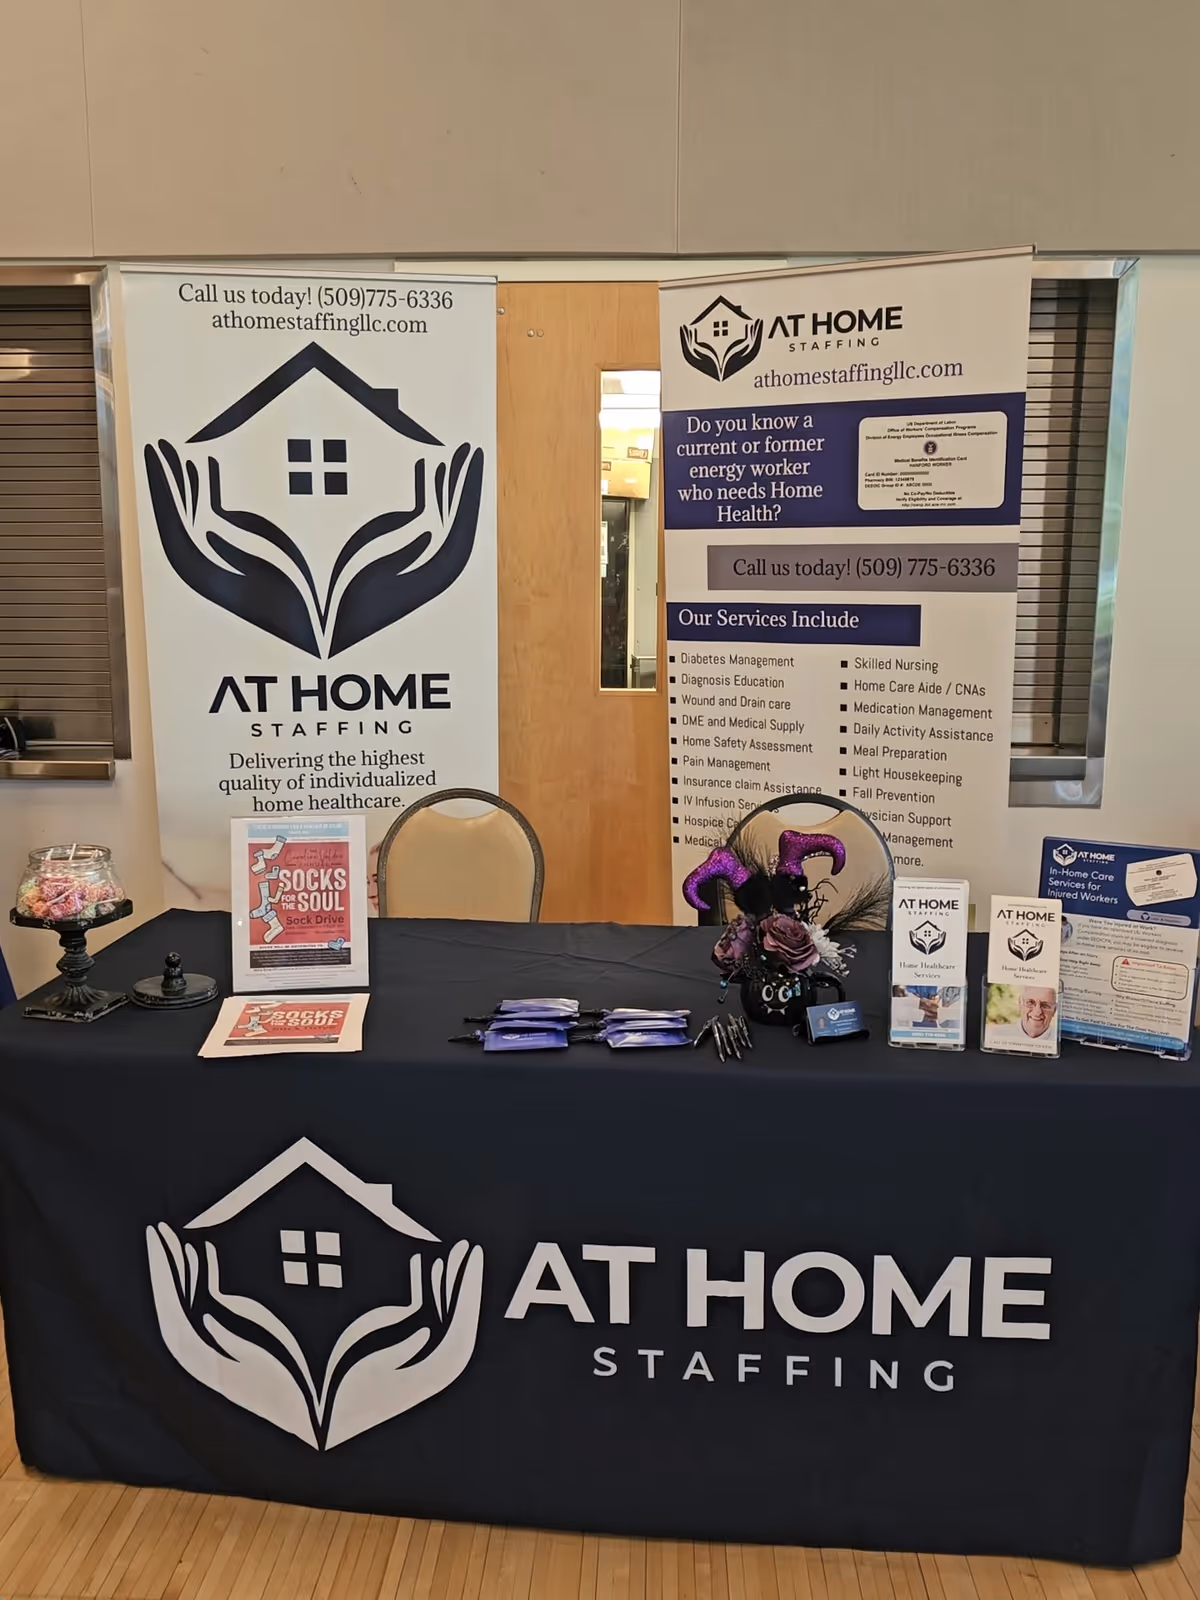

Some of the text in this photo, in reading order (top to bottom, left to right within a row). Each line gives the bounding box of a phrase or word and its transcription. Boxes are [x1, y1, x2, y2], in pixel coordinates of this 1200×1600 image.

[179, 283, 453, 310] Call us today! (509)775-6336
[212, 310, 428, 337] athomestaffingllc.com
[768, 306, 903, 339] AT HOME
[788, 337, 880, 352] STAFFING
[753, 361, 964, 388] athomestaffingllc.com
[686, 413, 814, 437] Do you know a
[676, 436, 825, 457] current or former
[689, 458, 811, 482] energy worker
[677, 481, 823, 502] who needs Home
[717, 504, 782, 522] Health?
[733, 557, 996, 580] Call us today! (509) 775-6336
[678, 608, 860, 629] Our Services Include
[680, 652, 795, 668] Diabetes Management
[854, 657, 939, 674] Skilled Nursing
[681, 673, 785, 688] Diagnosis Education
[854, 679, 886, 692] Home
[889, 681, 915, 693] Care
[918, 682, 943, 694] Aide
[955, 683, 986, 697] CNAs
[208, 673, 452, 714] AT HOME
[681, 694, 792, 711] Wound and Drain care
[854, 701, 993, 720] Medication Management
[250, 720, 413, 738] STAFFING
[682, 714, 805, 734] DME and Medical Supply
[853, 723, 994, 742] Daily Activity Assistance
[682, 735, 813, 754] Home Safety Assessment
[853, 745, 947, 761] Meal Preparation
[229, 750, 426, 771] Delivering the highest
[683, 755, 771, 772] Pain Management
[218, 770, 437, 796] quality of individualized
[683, 775, 822, 795] Insurance claim Assistance
[852, 766, 963, 787] Light Housekeeping
[253, 794, 406, 812] home healthcare.
[683, 796, 693, 806] IV
[695, 797, 735, 809] Infusion
[852, 787, 936, 804] Fall Prevention
[685, 815, 724, 828] Hospice
[908, 811, 952, 828] Support
[685, 835, 723, 847] Medical
[882, 832, 954, 848] Management
[893, 855, 924, 867] more.
[1090, 852, 1116, 862] HOME
[279, 868, 347, 891] SOCKS
[1049, 867, 1114, 882] In-Home Care
[1048, 877, 1101, 891] Services for
[281, 894, 296, 902] FOR
[297, 891, 345, 912] SOUL
[898, 898, 959, 910] AT HOME
[1047, 888, 1118, 905] Injured Workers
[282, 902, 296, 910] THE
[286, 916, 313, 926] Sock
[315, 915, 345, 924] Drive
[997, 909, 1056, 922] AT HOME
[920, 961, 956, 969] Healthcare
[913, 971, 941, 979] Services
[272, 1010, 344, 1020] SOCKS
[287, 1018, 338, 1026] SOUL
[503, 1241, 1052, 1340] AT HOME
[592, 1346, 955, 1392] STAFFING
